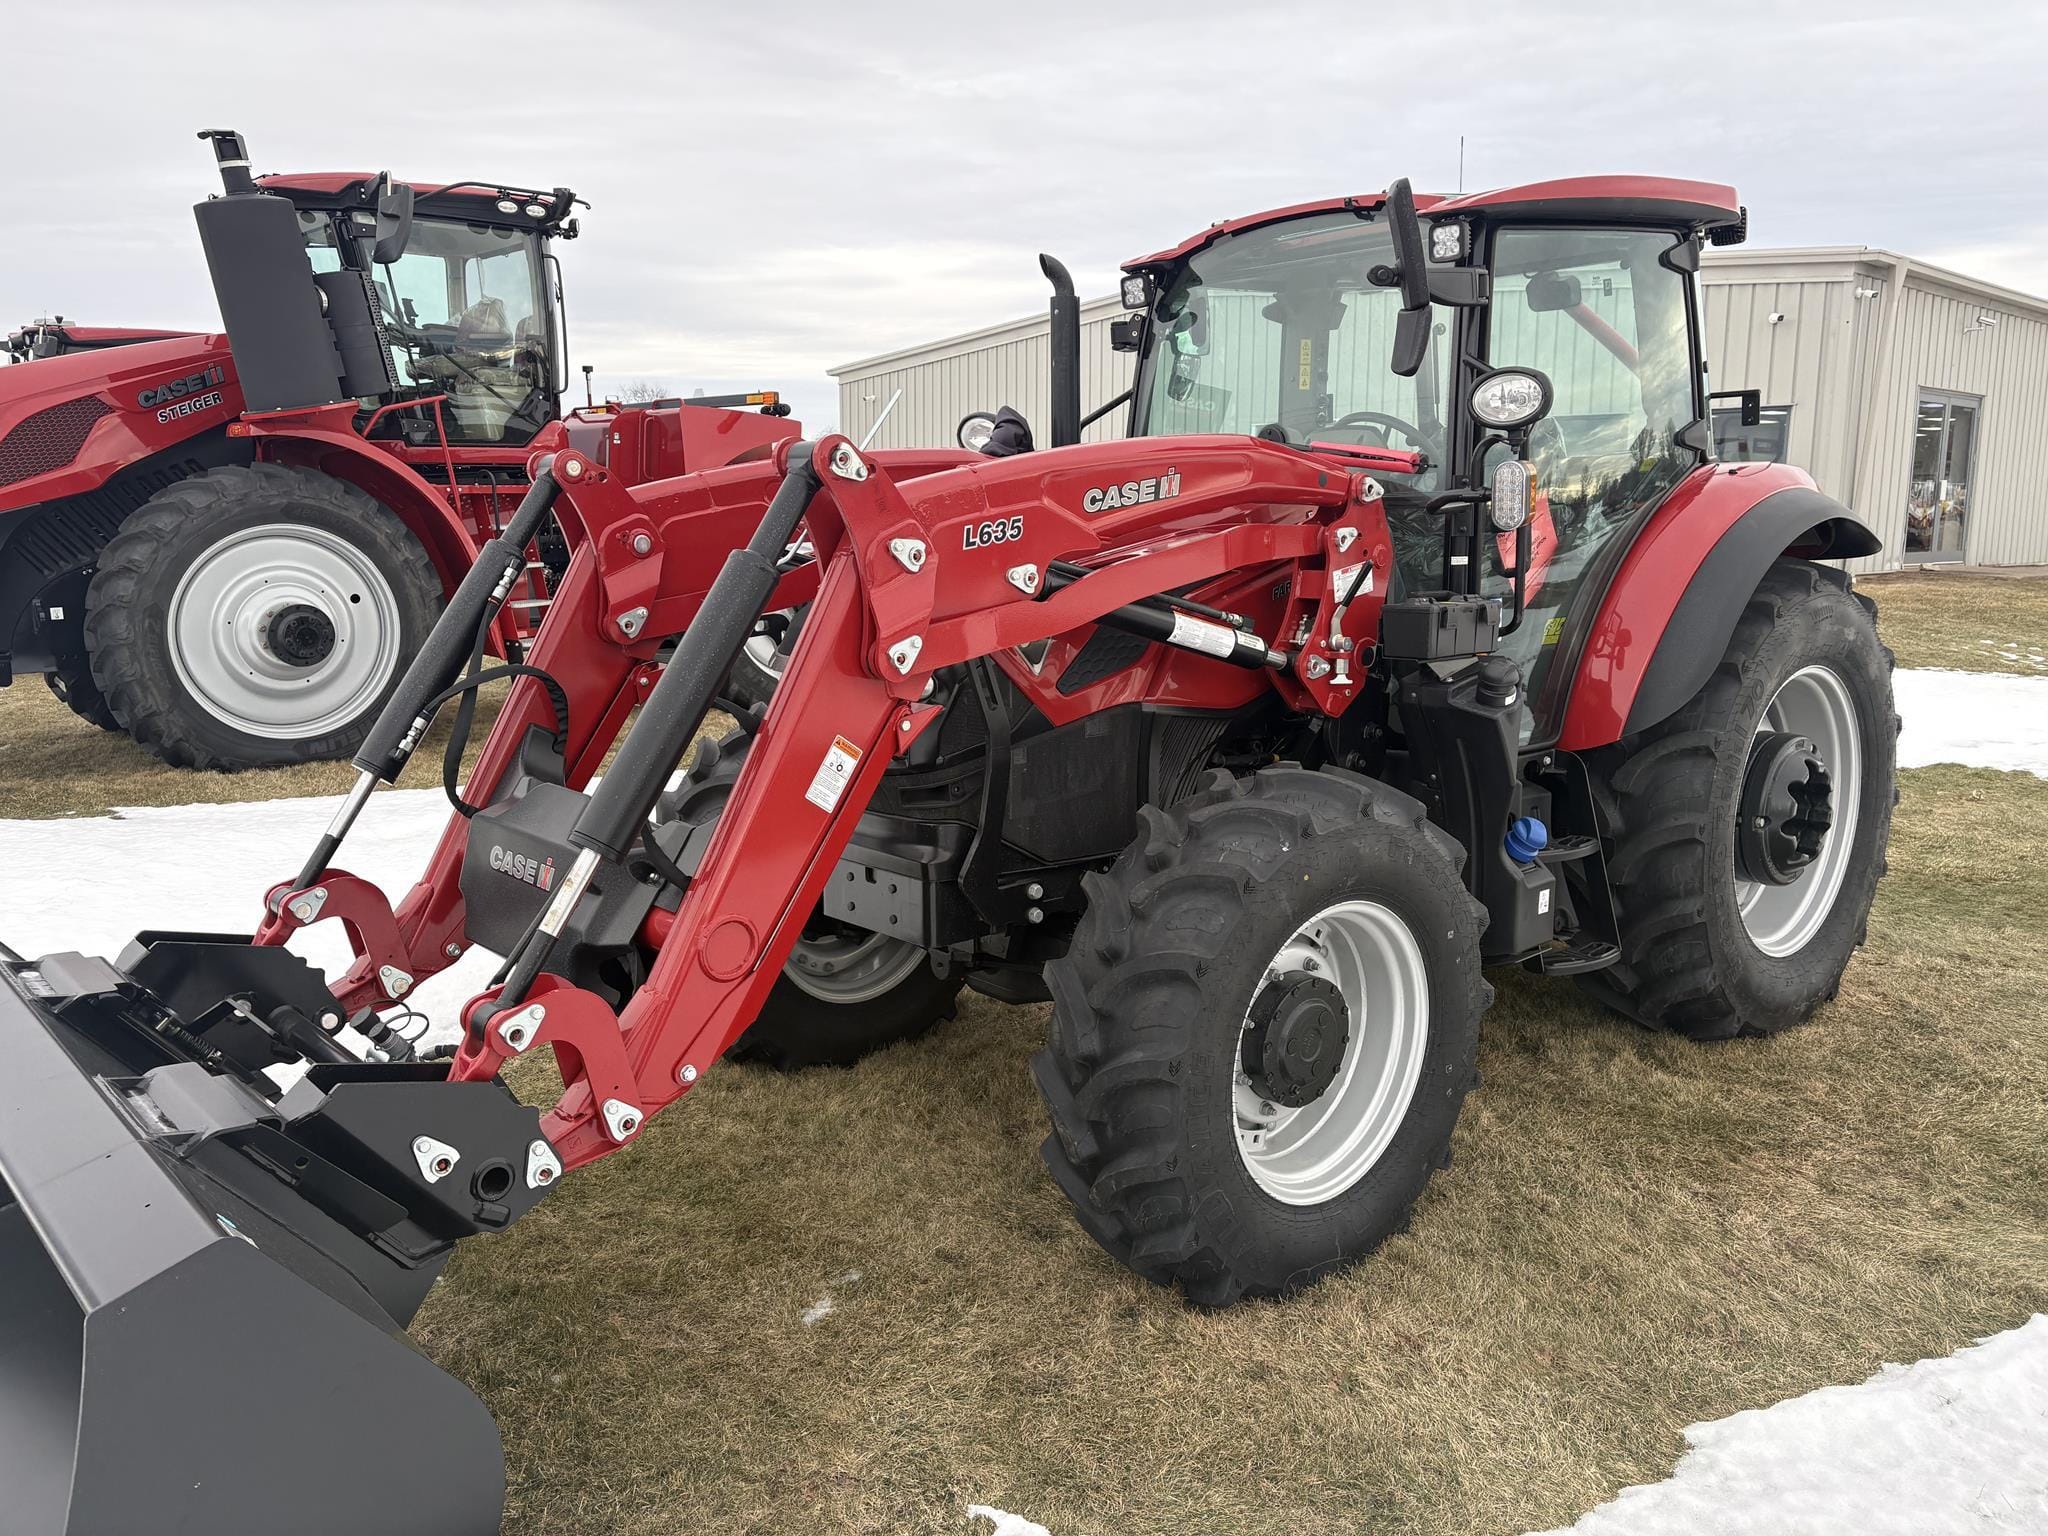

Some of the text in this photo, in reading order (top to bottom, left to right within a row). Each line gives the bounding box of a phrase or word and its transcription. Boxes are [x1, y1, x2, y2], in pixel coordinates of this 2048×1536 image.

[137, 373, 202, 409] CASE
[157, 391, 224, 423] STEIGER
[1082, 479, 1157, 513] CASE
[962, 515, 1024, 550] L635
[489, 845, 538, 885] CASE
